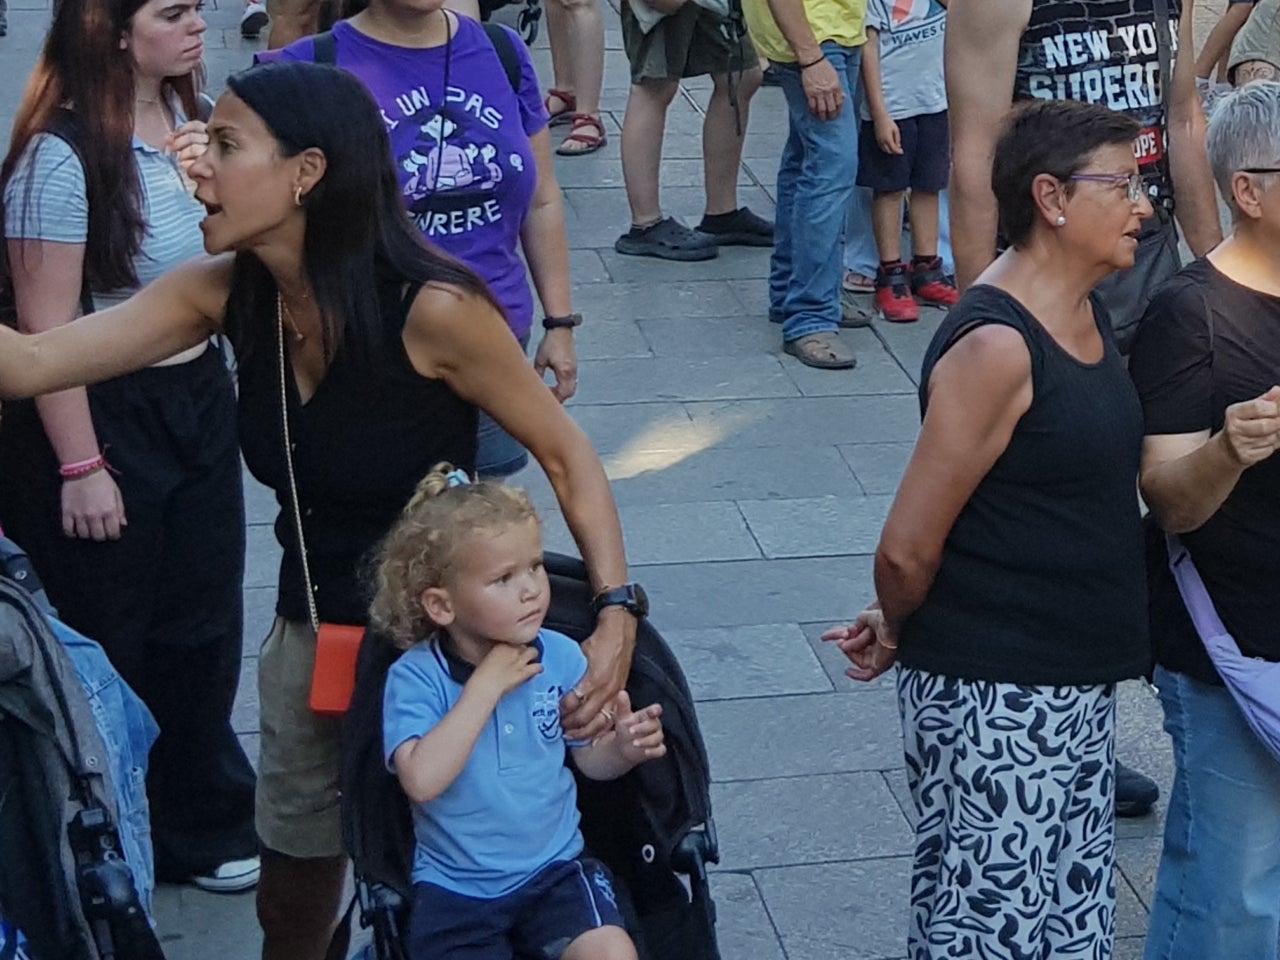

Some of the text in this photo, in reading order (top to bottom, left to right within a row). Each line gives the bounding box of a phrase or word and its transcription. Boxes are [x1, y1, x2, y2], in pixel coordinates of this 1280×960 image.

[891, 25, 937, 45] WAVES
[1042, 19, 1179, 69] NEW YOK
[396, 86, 431, 117] UN
